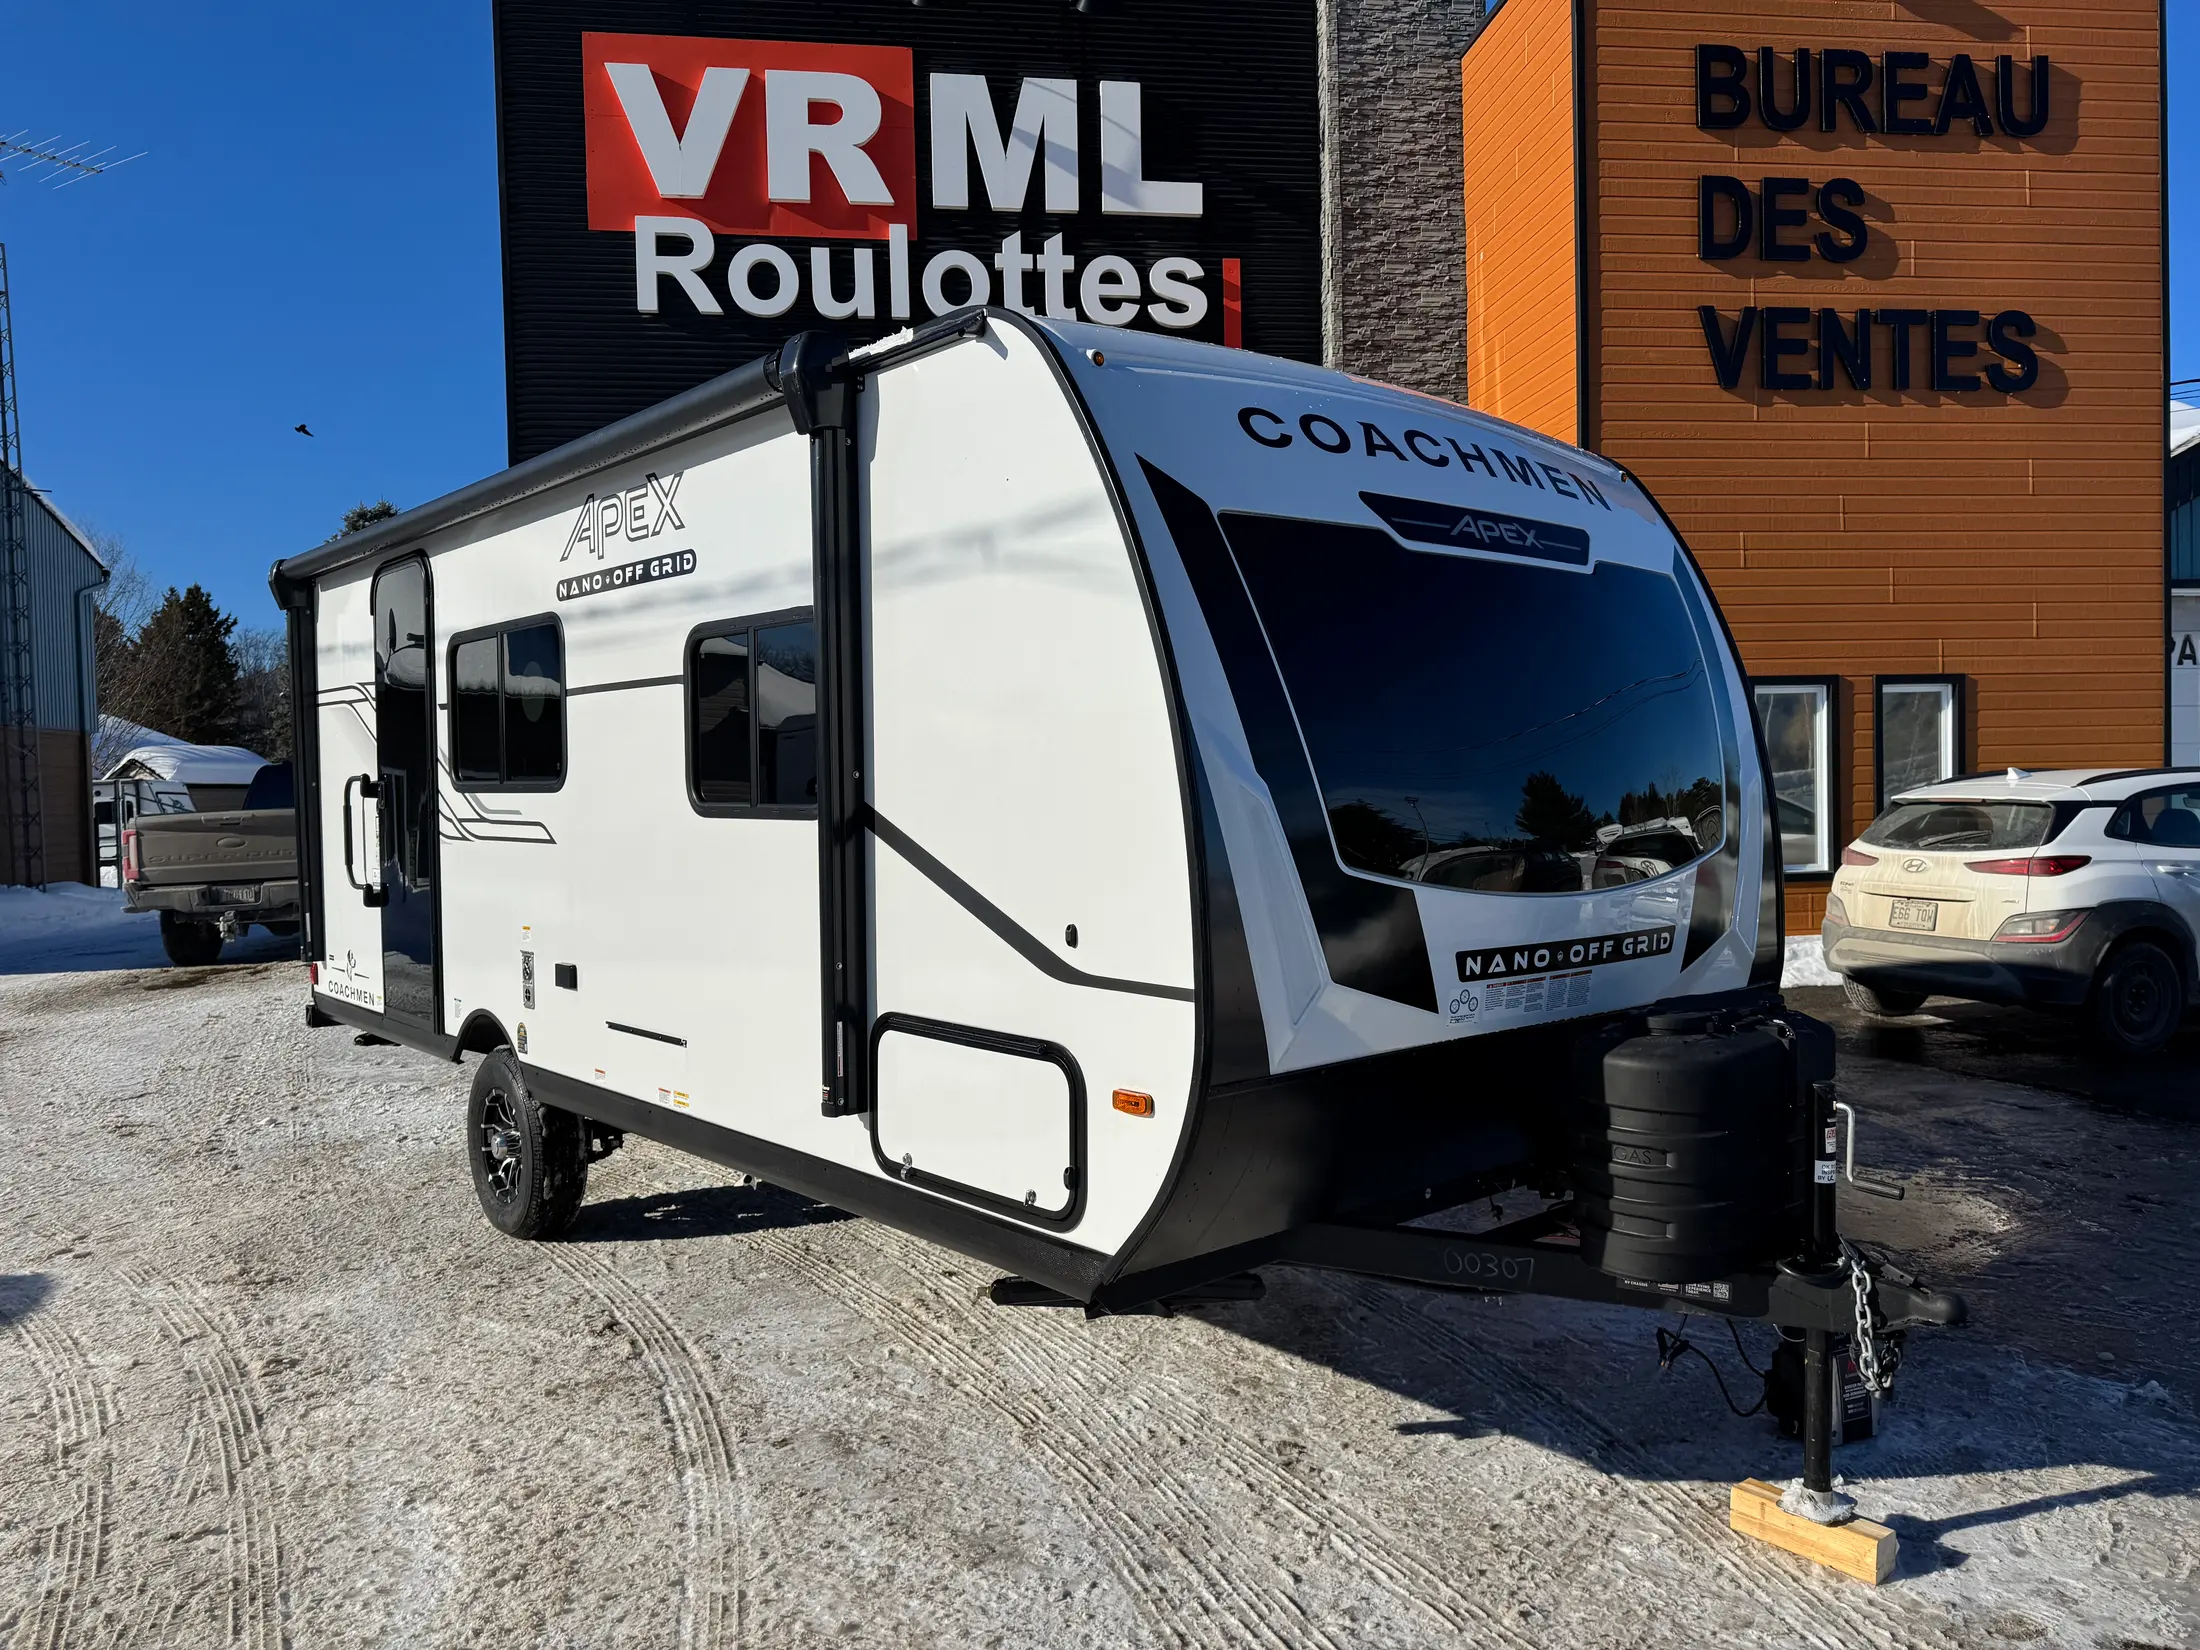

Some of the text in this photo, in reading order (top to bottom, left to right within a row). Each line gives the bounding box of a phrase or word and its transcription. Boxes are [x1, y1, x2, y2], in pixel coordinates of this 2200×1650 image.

[1696, 43, 2050, 138] BUREAU
[603, 61, 1204, 217] VRML
[1698, 174, 1868, 264] DES
[634, 214, 1209, 330] Roulottes
[1697, 305, 2040, 394] VENTES
[1237, 406, 1613, 512] COACHMEN
[559, 470, 686, 563] APEX
[1448, 513, 1545, 550] APEX
[558, 552, 694, 599] NANO OFF GRID
[327, 979, 376, 1007] COACHMEN
[1465, 931, 1672, 977] NANO OFF GRID
[1613, 1146, 1652, 1165] GAS
[1443, 1246, 1535, 1288] 00307
